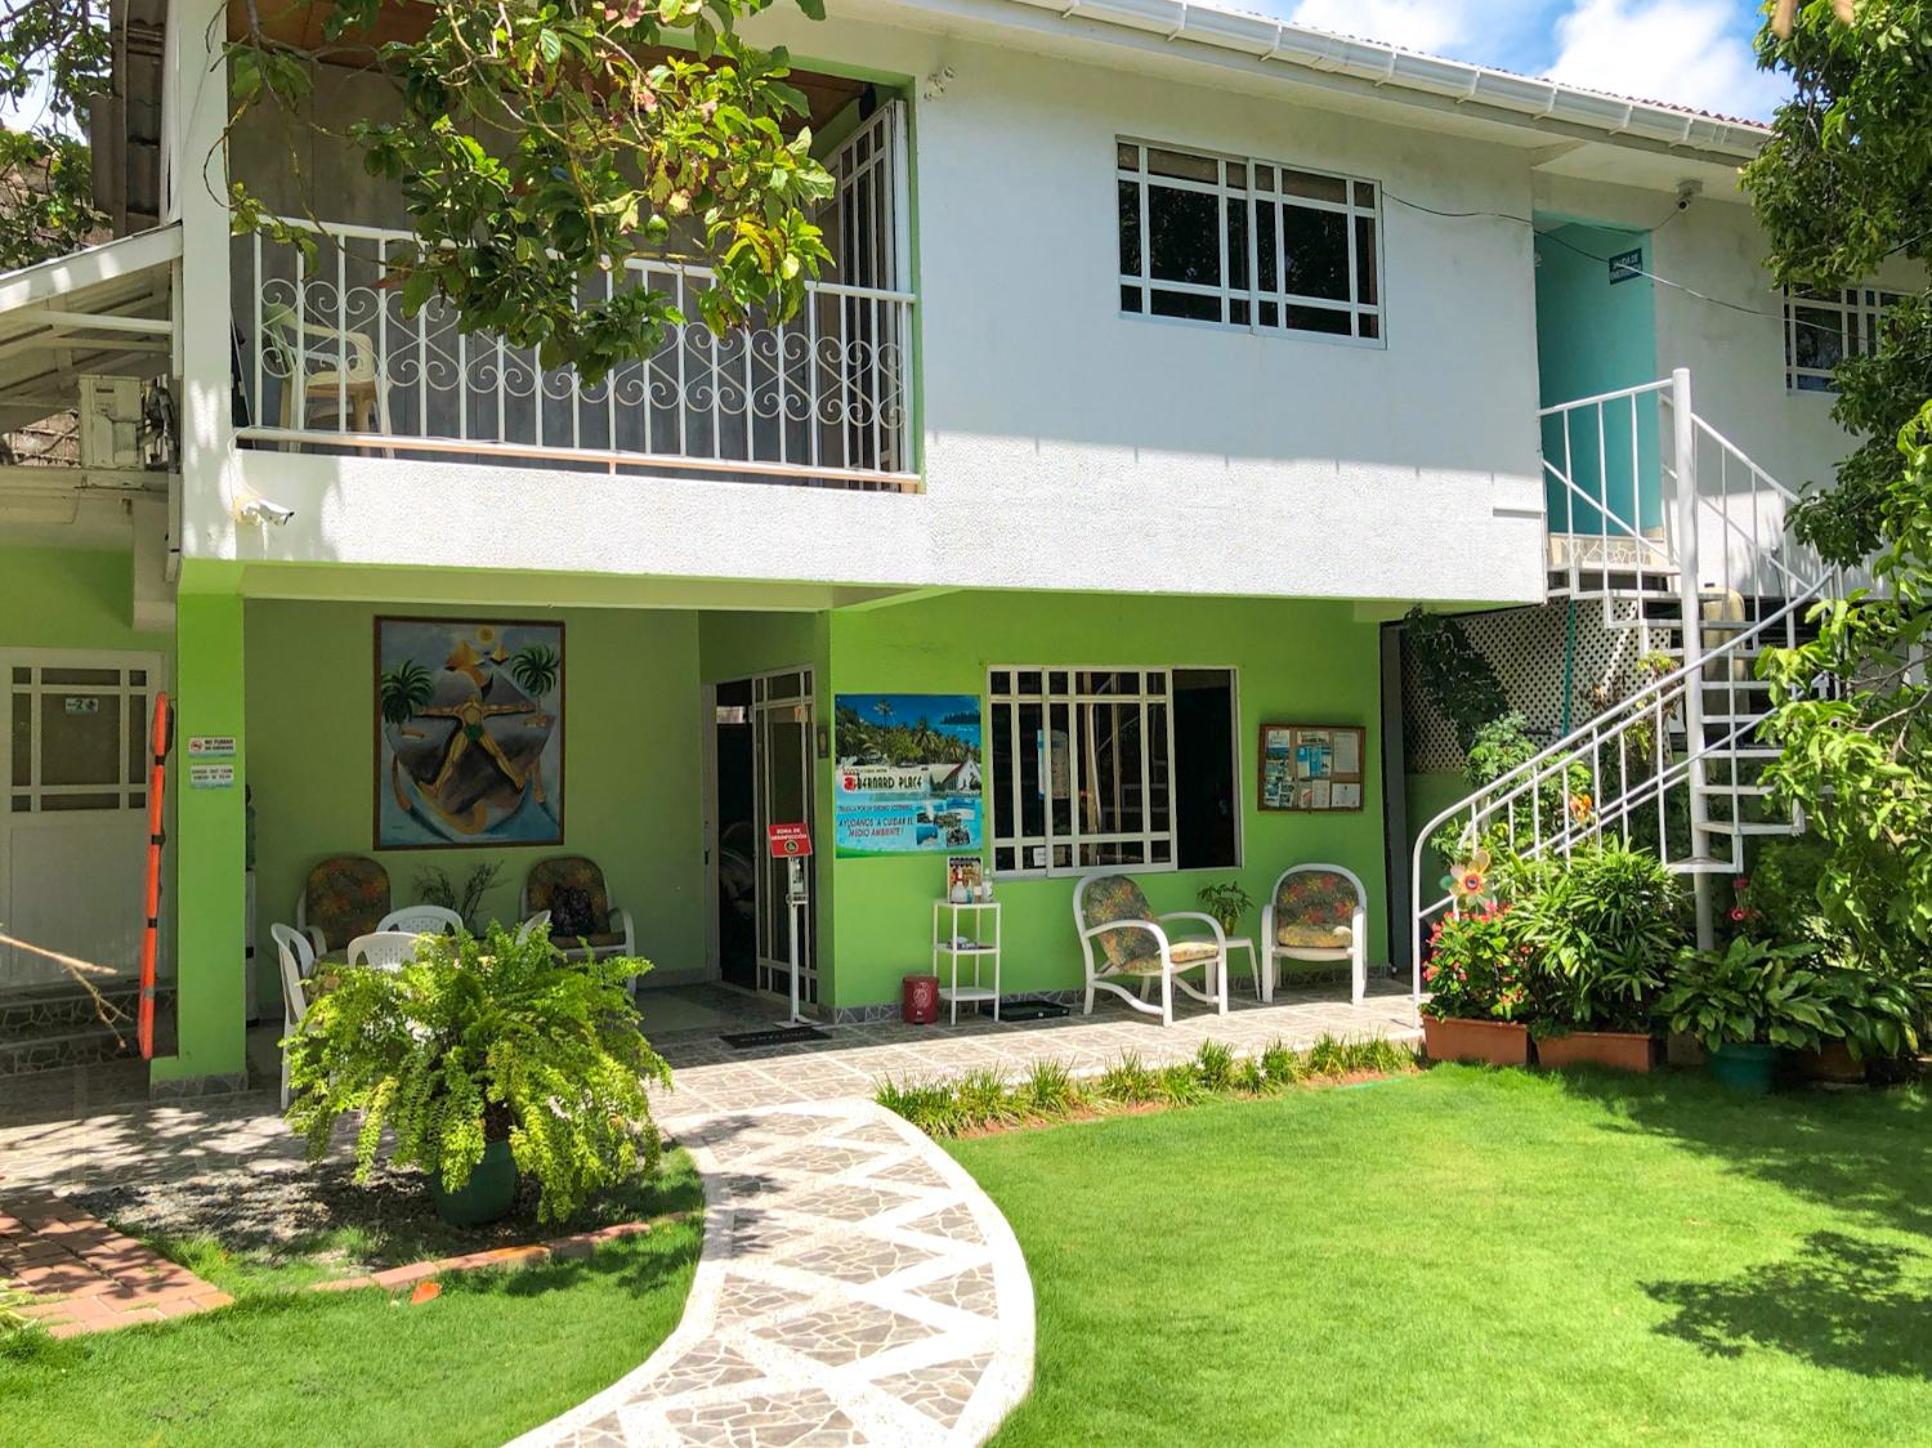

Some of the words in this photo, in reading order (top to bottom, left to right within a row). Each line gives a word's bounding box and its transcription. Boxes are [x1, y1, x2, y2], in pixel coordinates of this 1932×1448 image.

[857, 773, 895, 790] BERNARD
[898, 775, 922, 789] PLACE
[848, 827, 870, 838] MEDIO
